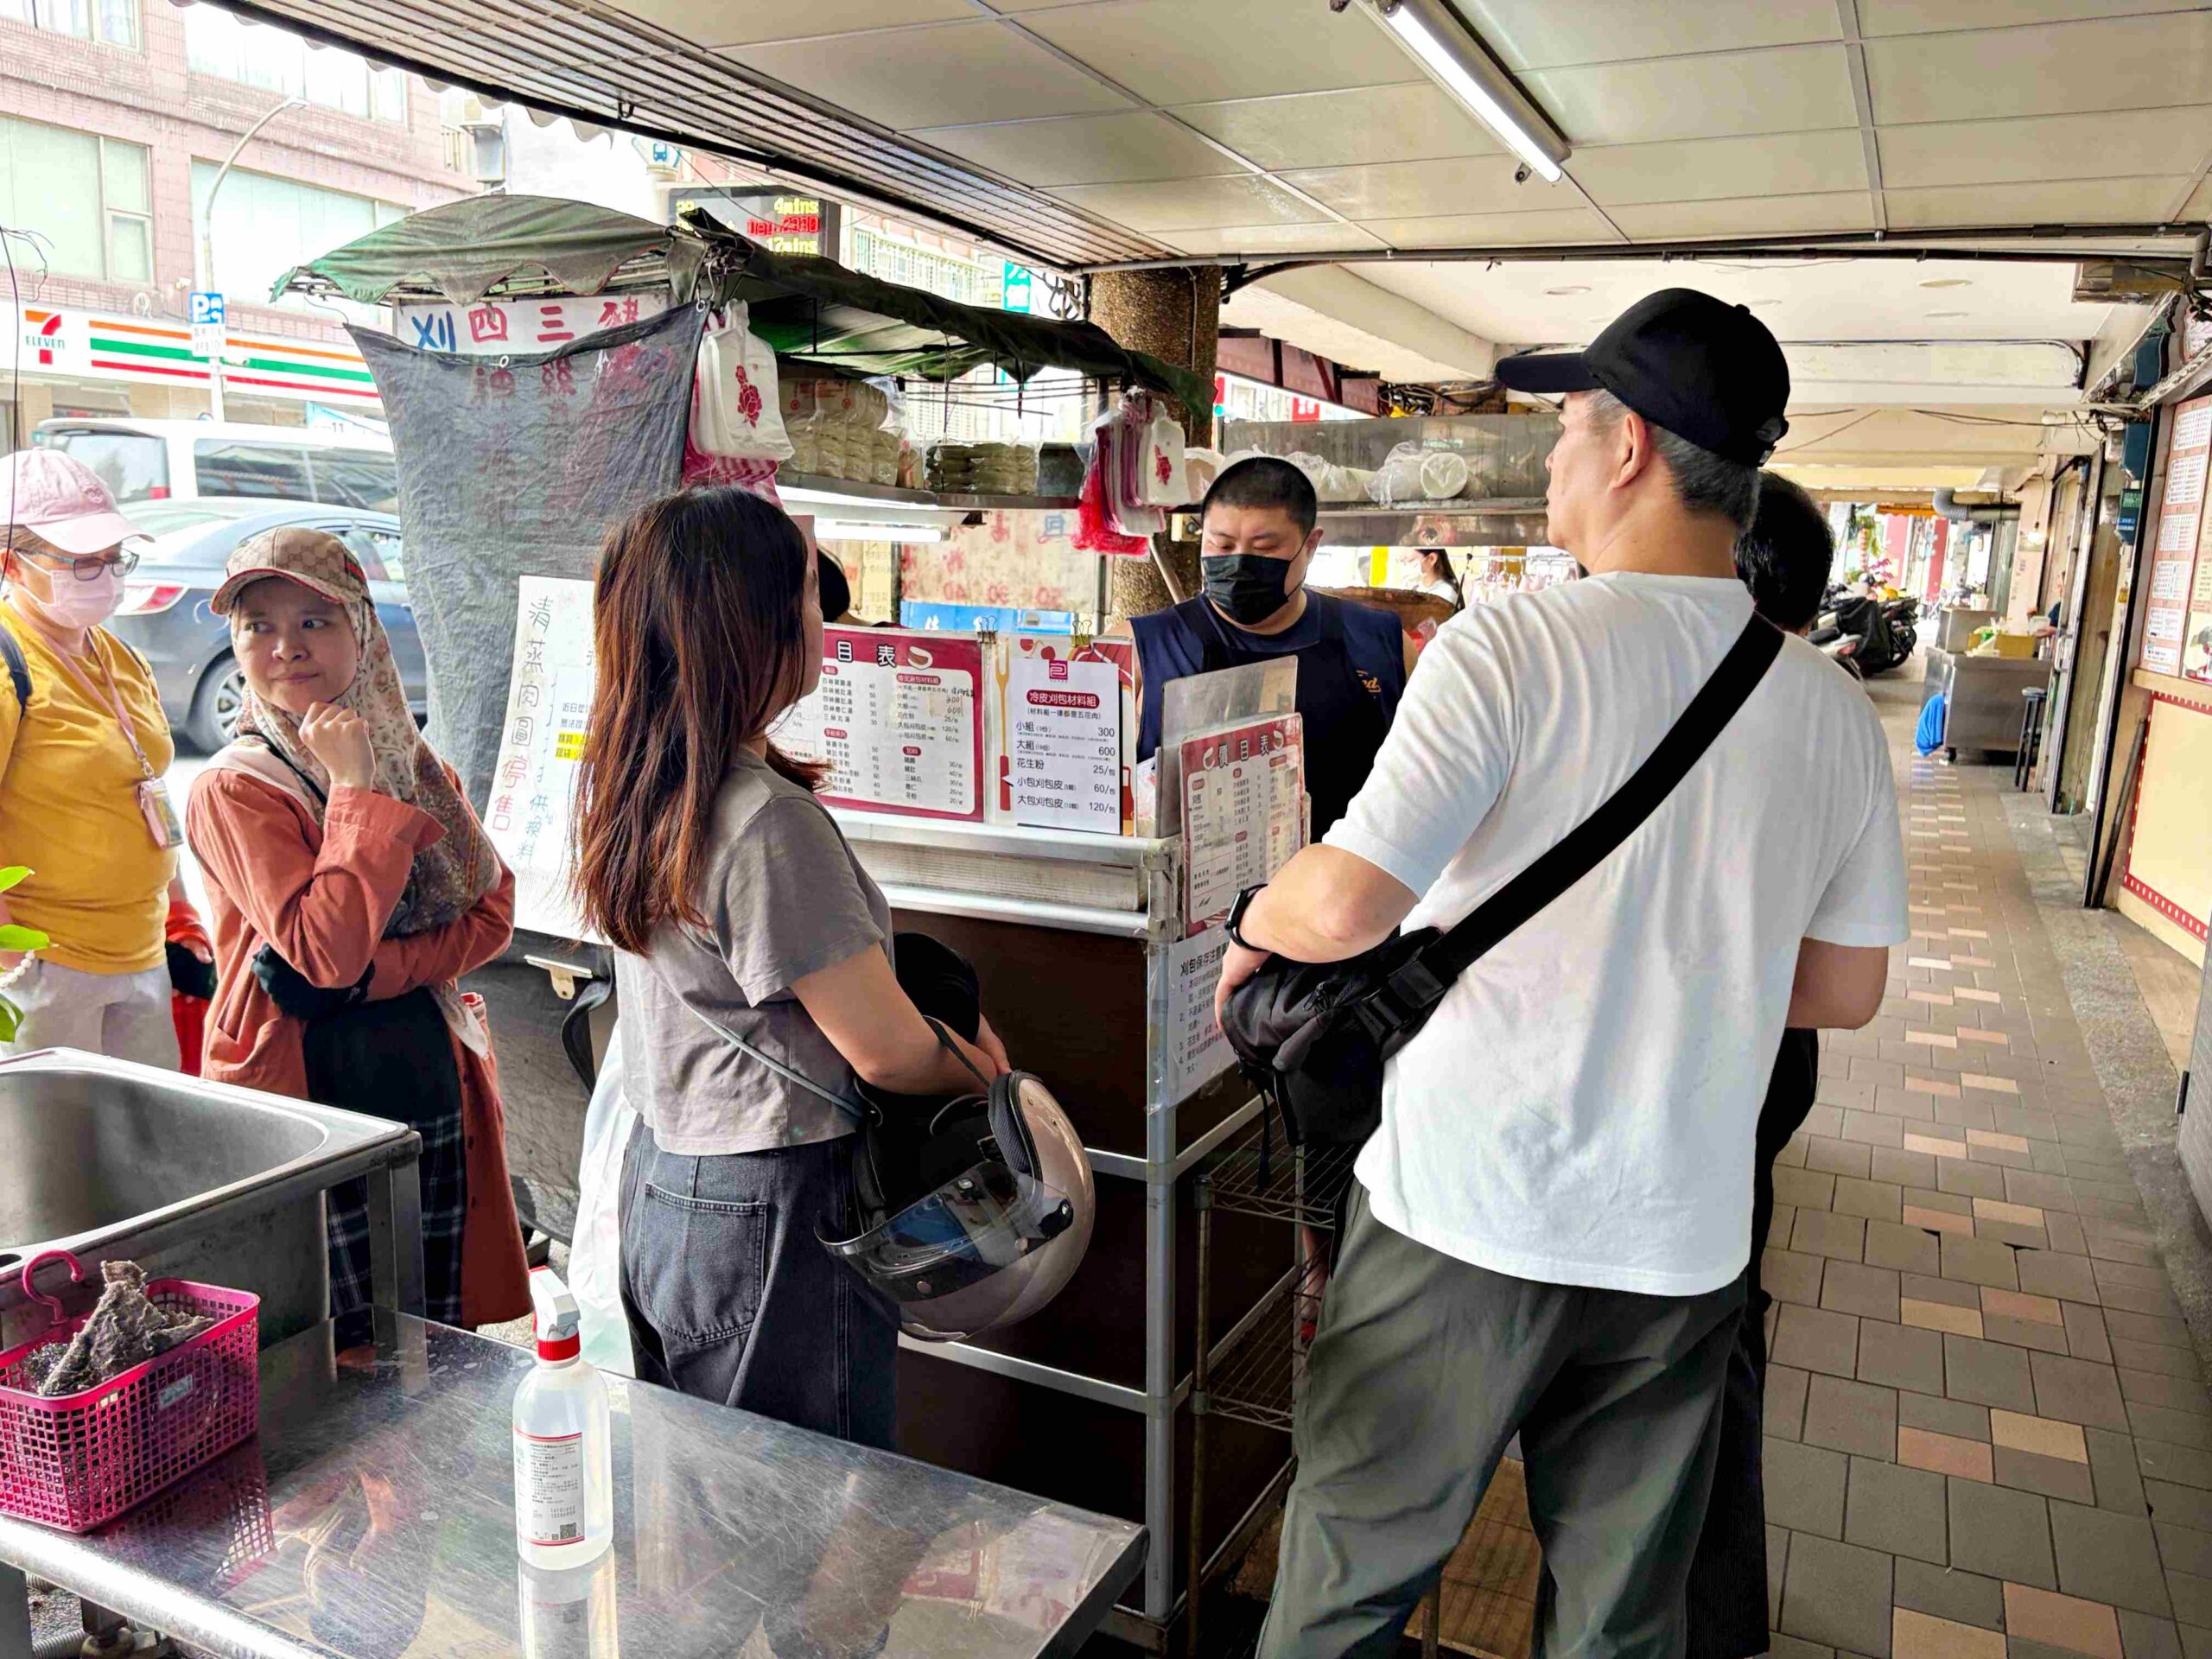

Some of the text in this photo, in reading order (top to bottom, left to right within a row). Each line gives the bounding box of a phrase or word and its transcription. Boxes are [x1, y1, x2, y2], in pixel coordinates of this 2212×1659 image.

[192, 295, 210, 323] P
[25, 309, 61, 365] 7
[1029, 691, 1097, 707] 冷皮刈包材料組
[1016, 721, 1034, 733] 小組
[1097, 727, 1116, 738] 300
[1016, 740, 1034, 751] 大組
[1098, 746, 1116, 757] 600
[1017, 758, 1116, 776] 花生粉 25/包
[1094, 783, 1116, 795] 60/包
[1089, 801, 1116, 814] 120/包
